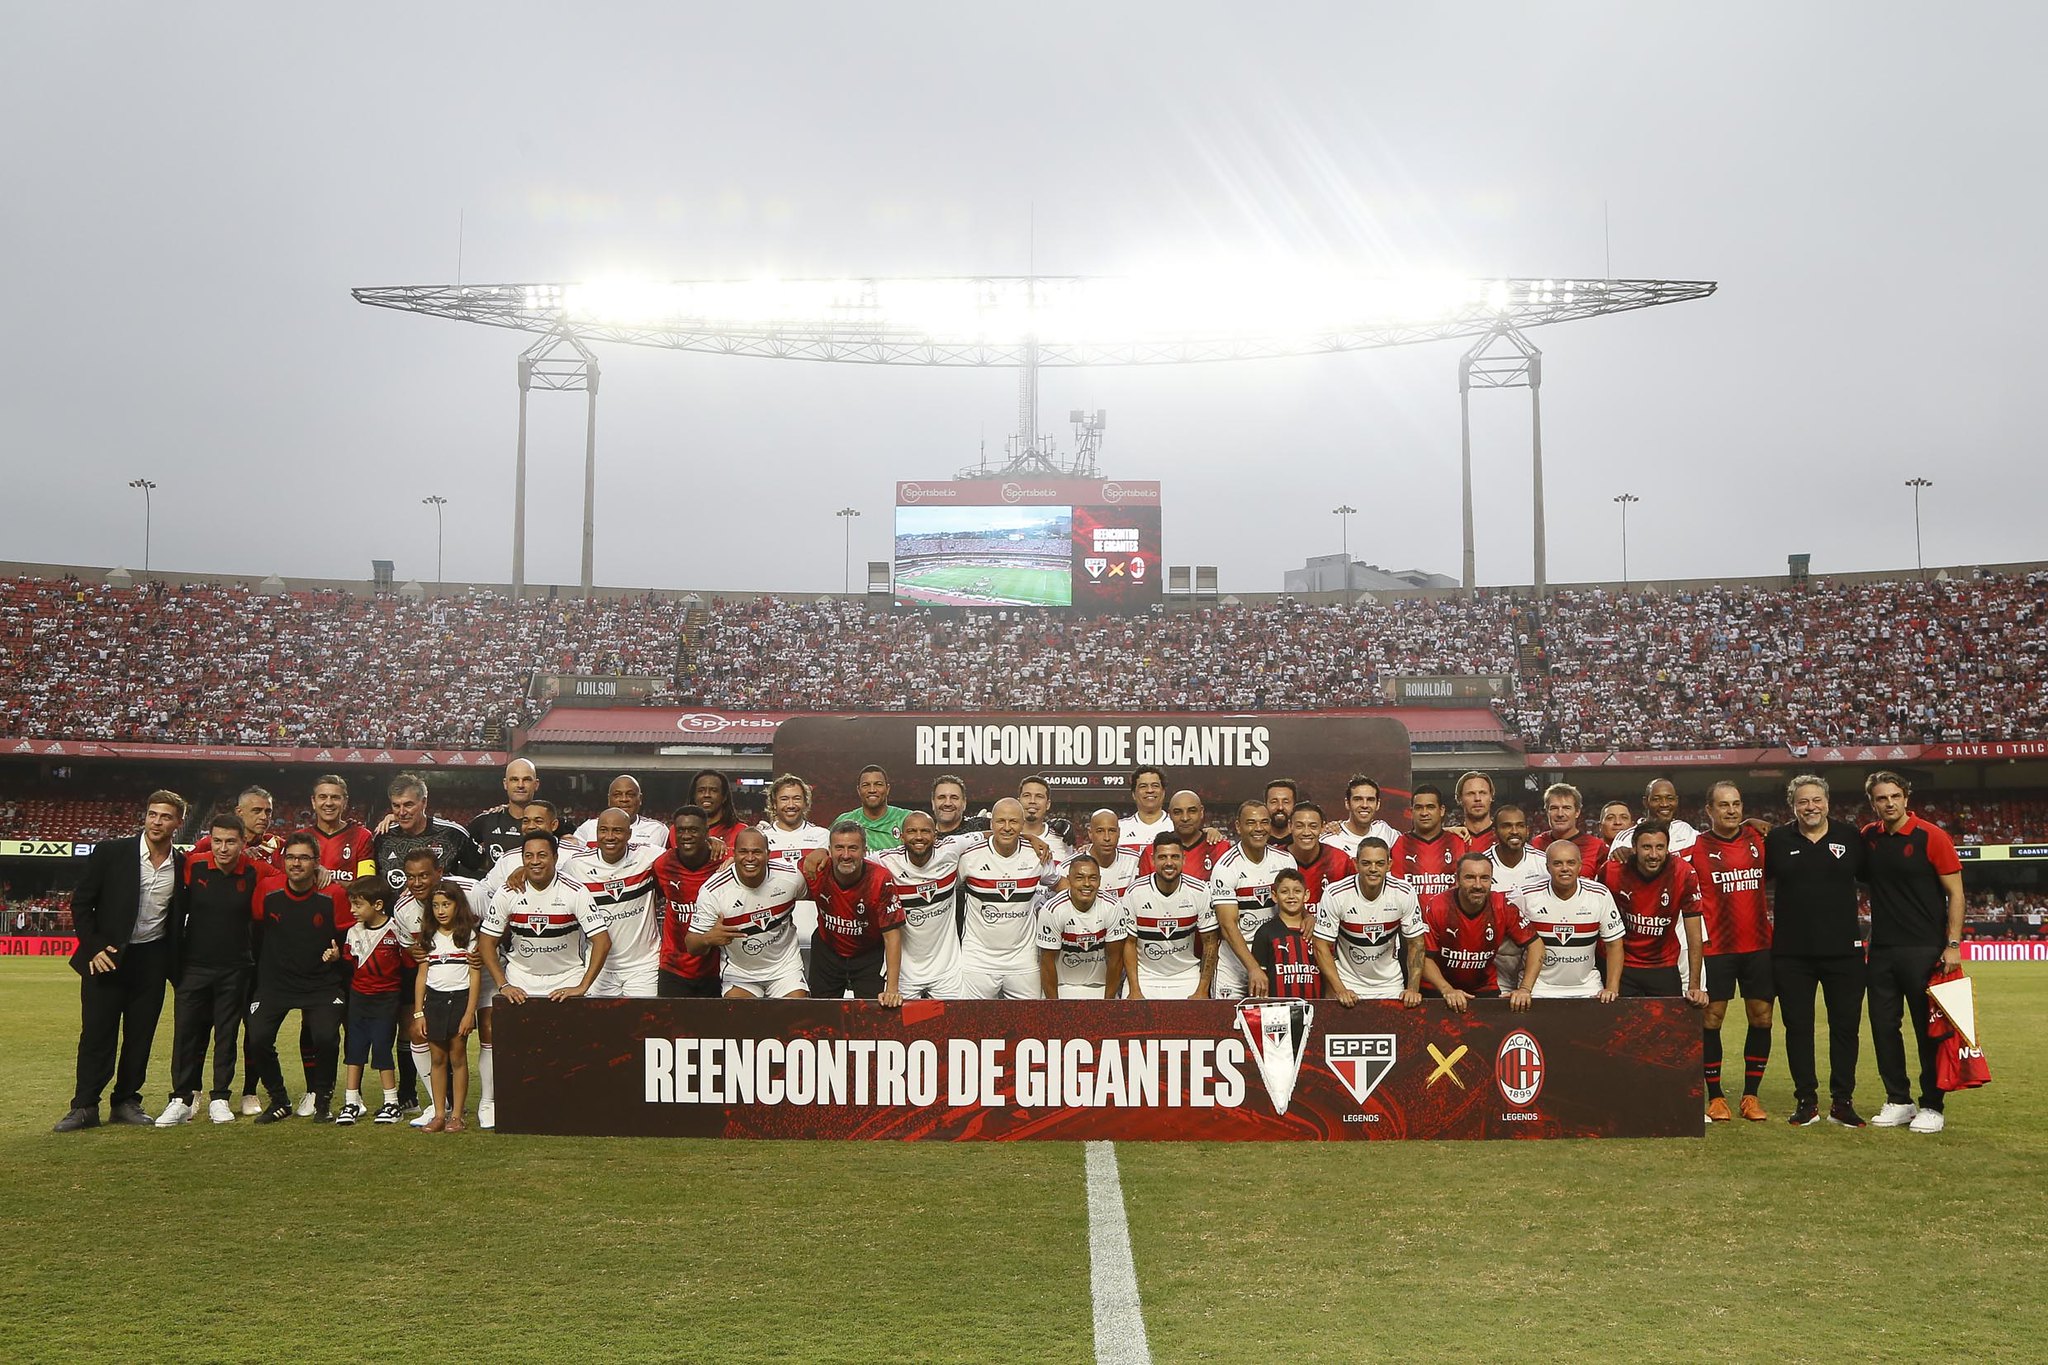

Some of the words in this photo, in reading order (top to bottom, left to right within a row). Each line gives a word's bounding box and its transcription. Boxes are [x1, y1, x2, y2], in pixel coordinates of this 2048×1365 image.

[906, 487, 956, 498] Sportsbet.io
[1006, 487, 1056, 498] Sportsbet.io
[1107, 487, 1157, 498] Sportsbet.io
[576, 681, 616, 696] ADILSON
[1405, 680, 1453, 697] RONALDÃO
[916, 724, 1092, 766] REENCONTRO
[1097, 725, 1131, 767] DE
[1136, 725, 1271, 767] GIGANTES
[1946, 745, 1988, 756] SALVE
[1996, 744, 2003, 754] O
[2012, 743, 2045, 754] TRIC
[1061, 776, 1087, 785] PAULO
[1103, 776, 1124, 785] 1993
[20, 842, 69, 855] DAX
[327, 869, 354, 881] ates
[1405, 872, 1457, 884] Emirates
[1711, 867, 1763, 884] Emirates
[1723, 881, 1735, 893] FLY
[1736, 879, 1759, 891] BETTER
[603, 906, 645, 923] portsbet.io
[1626, 912, 1672, 927] mirates
[825, 921, 836, 931] FLY
[837, 926, 863, 936] BETTER
[1637, 925, 1664, 936] BETTER
[1038, 932, 1057, 943] Bitso
[40, 940, 73, 955] APP
[520, 942, 568, 955] Sportsbet.io
[1441, 946, 1495, 961] Emirates
[1970, 943, 2048, 961] DOWNLO
[1447, 959, 1460, 968] FLY
[1461, 960, 1487, 969] BETTER
[1284, 974, 1295, 984] FLY
[1332, 1040, 1389, 1055] SPFC
[1506, 1036, 1533, 1050] ACM
[645, 1037, 938, 1107] REENCONTRO
[948, 1039, 1006, 1107] DE
[1015, 1038, 1246, 1108] GIGANTES
[1509, 1089, 1532, 1099] 1899
[1343, 1114, 1379, 1123] LEGENDS
[1502, 1112, 1538, 1121] LEGENDS
